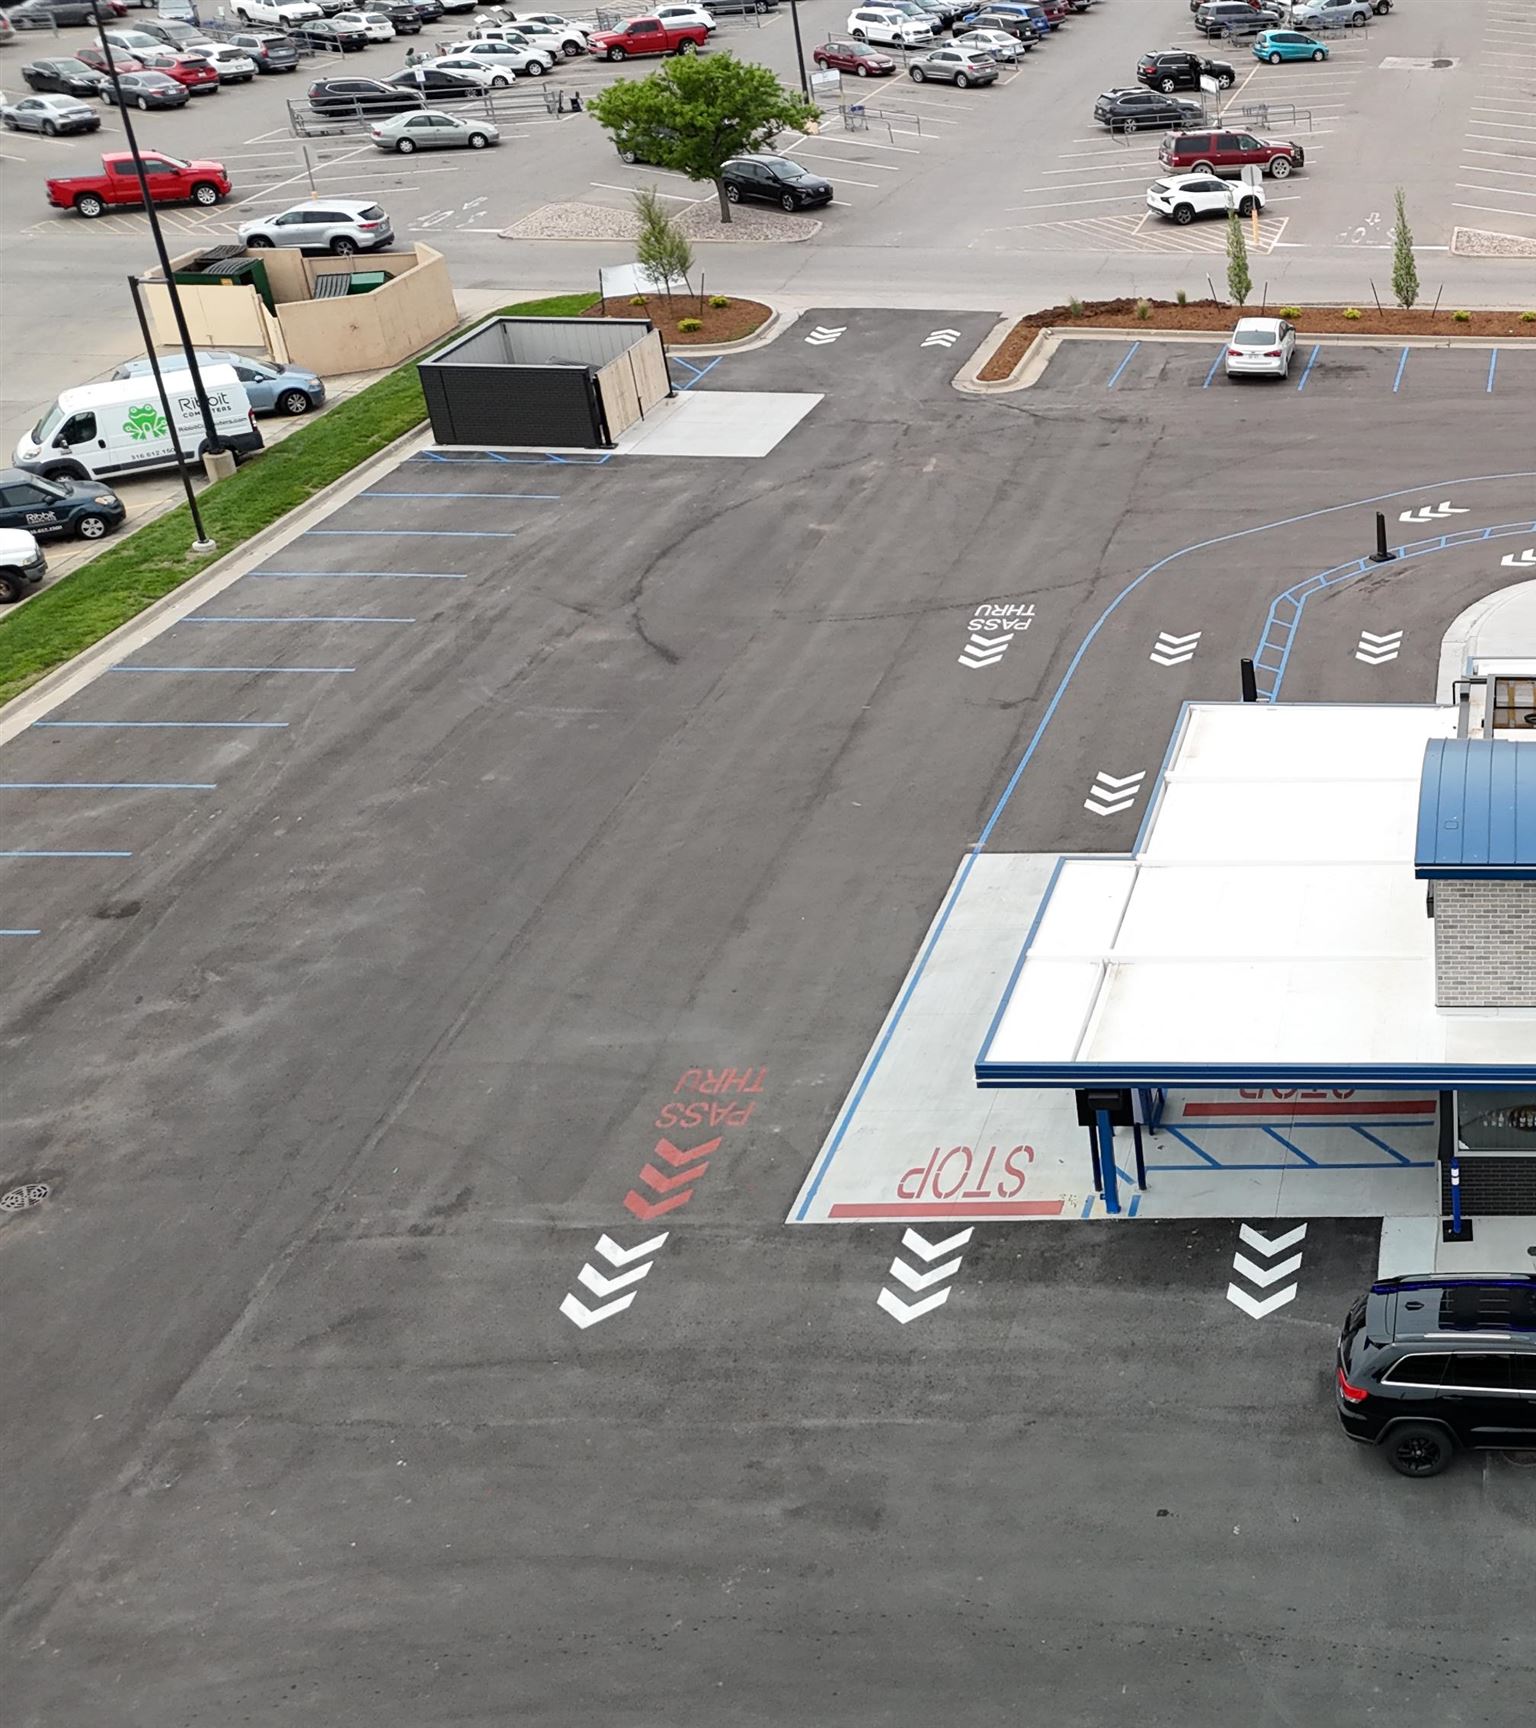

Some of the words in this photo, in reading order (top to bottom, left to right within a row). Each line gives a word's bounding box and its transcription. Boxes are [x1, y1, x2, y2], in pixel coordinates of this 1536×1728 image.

[183, 406, 232, 418] COMTERS
[974, 604, 1036, 616] THRU
[967, 618, 1032, 630] PASS
[673, 1065, 767, 1094] THRU
[655, 1101, 756, 1128] PASS
[897, 1145, 1034, 1199] STOP
